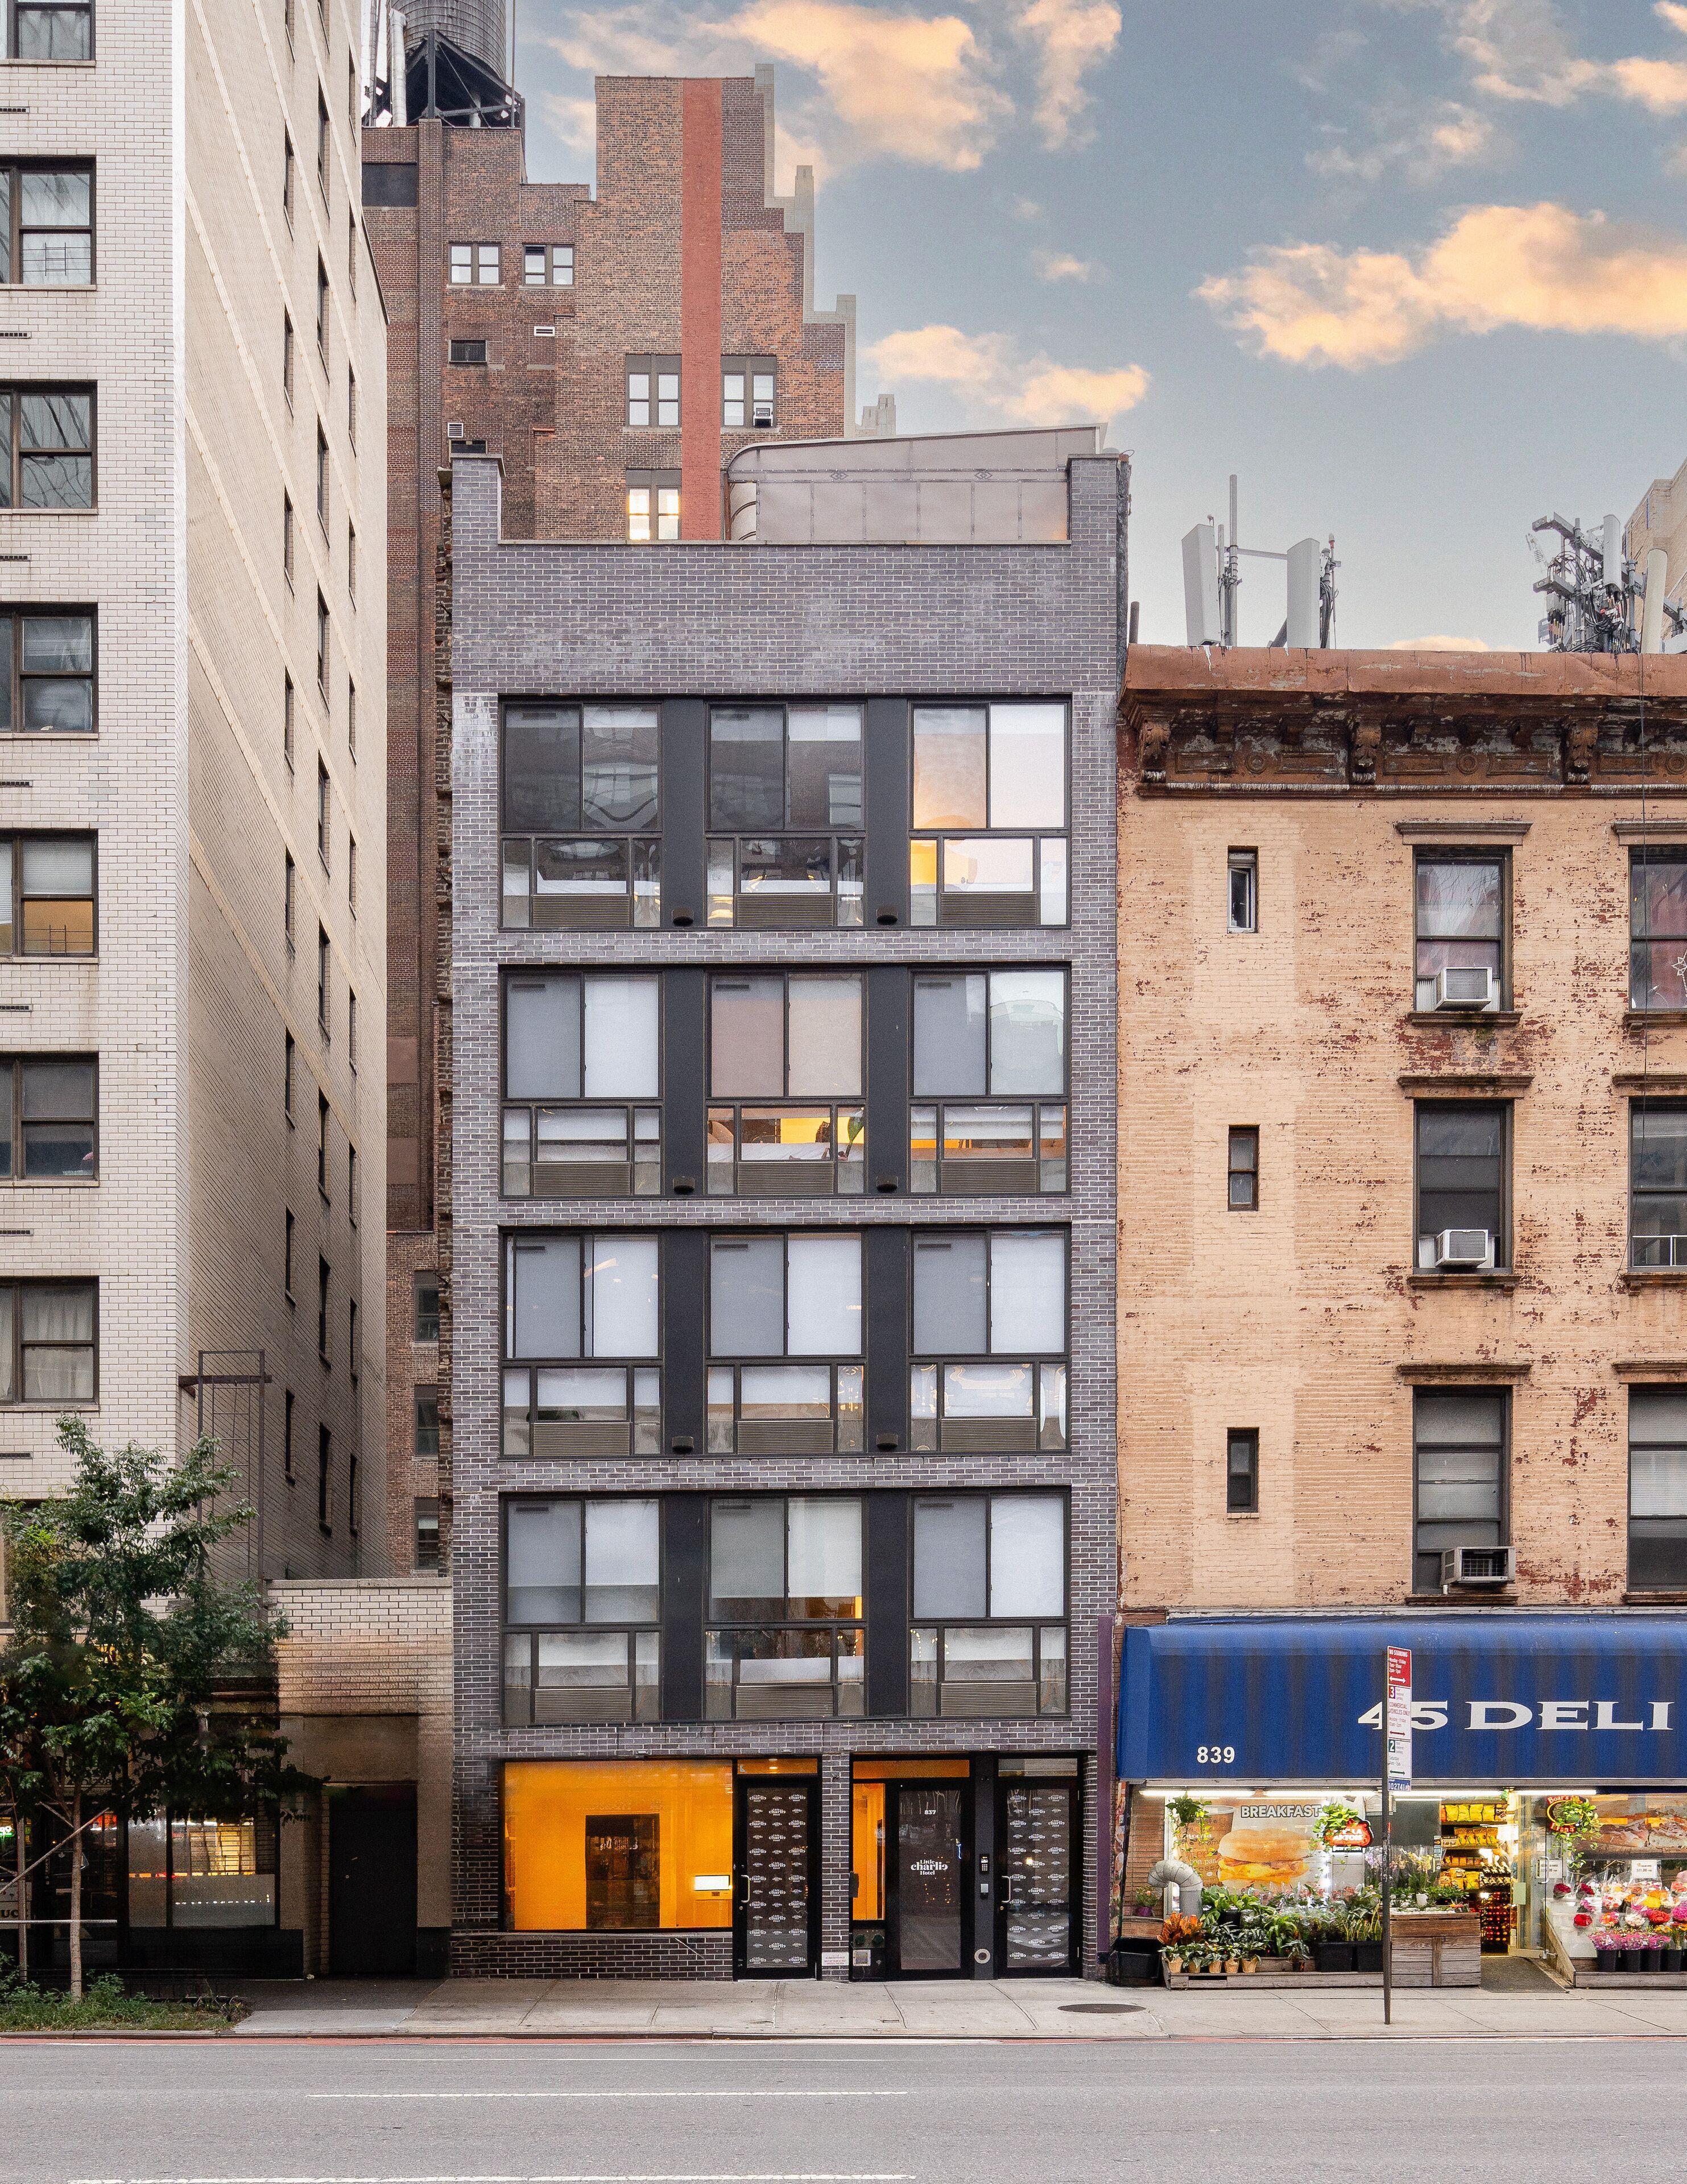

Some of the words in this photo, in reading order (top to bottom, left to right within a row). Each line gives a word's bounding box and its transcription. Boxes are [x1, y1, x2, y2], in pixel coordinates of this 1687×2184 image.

[1390, 1686, 1395, 1698] 3
[1464, 1701, 1674, 1731] DELI
[1390, 1740, 1395, 1752] 2
[1197, 1746, 1235, 1764] 839
[1241, 1805, 1321, 1818] BREAKFAST
[911, 1862, 948, 1871] charlie
